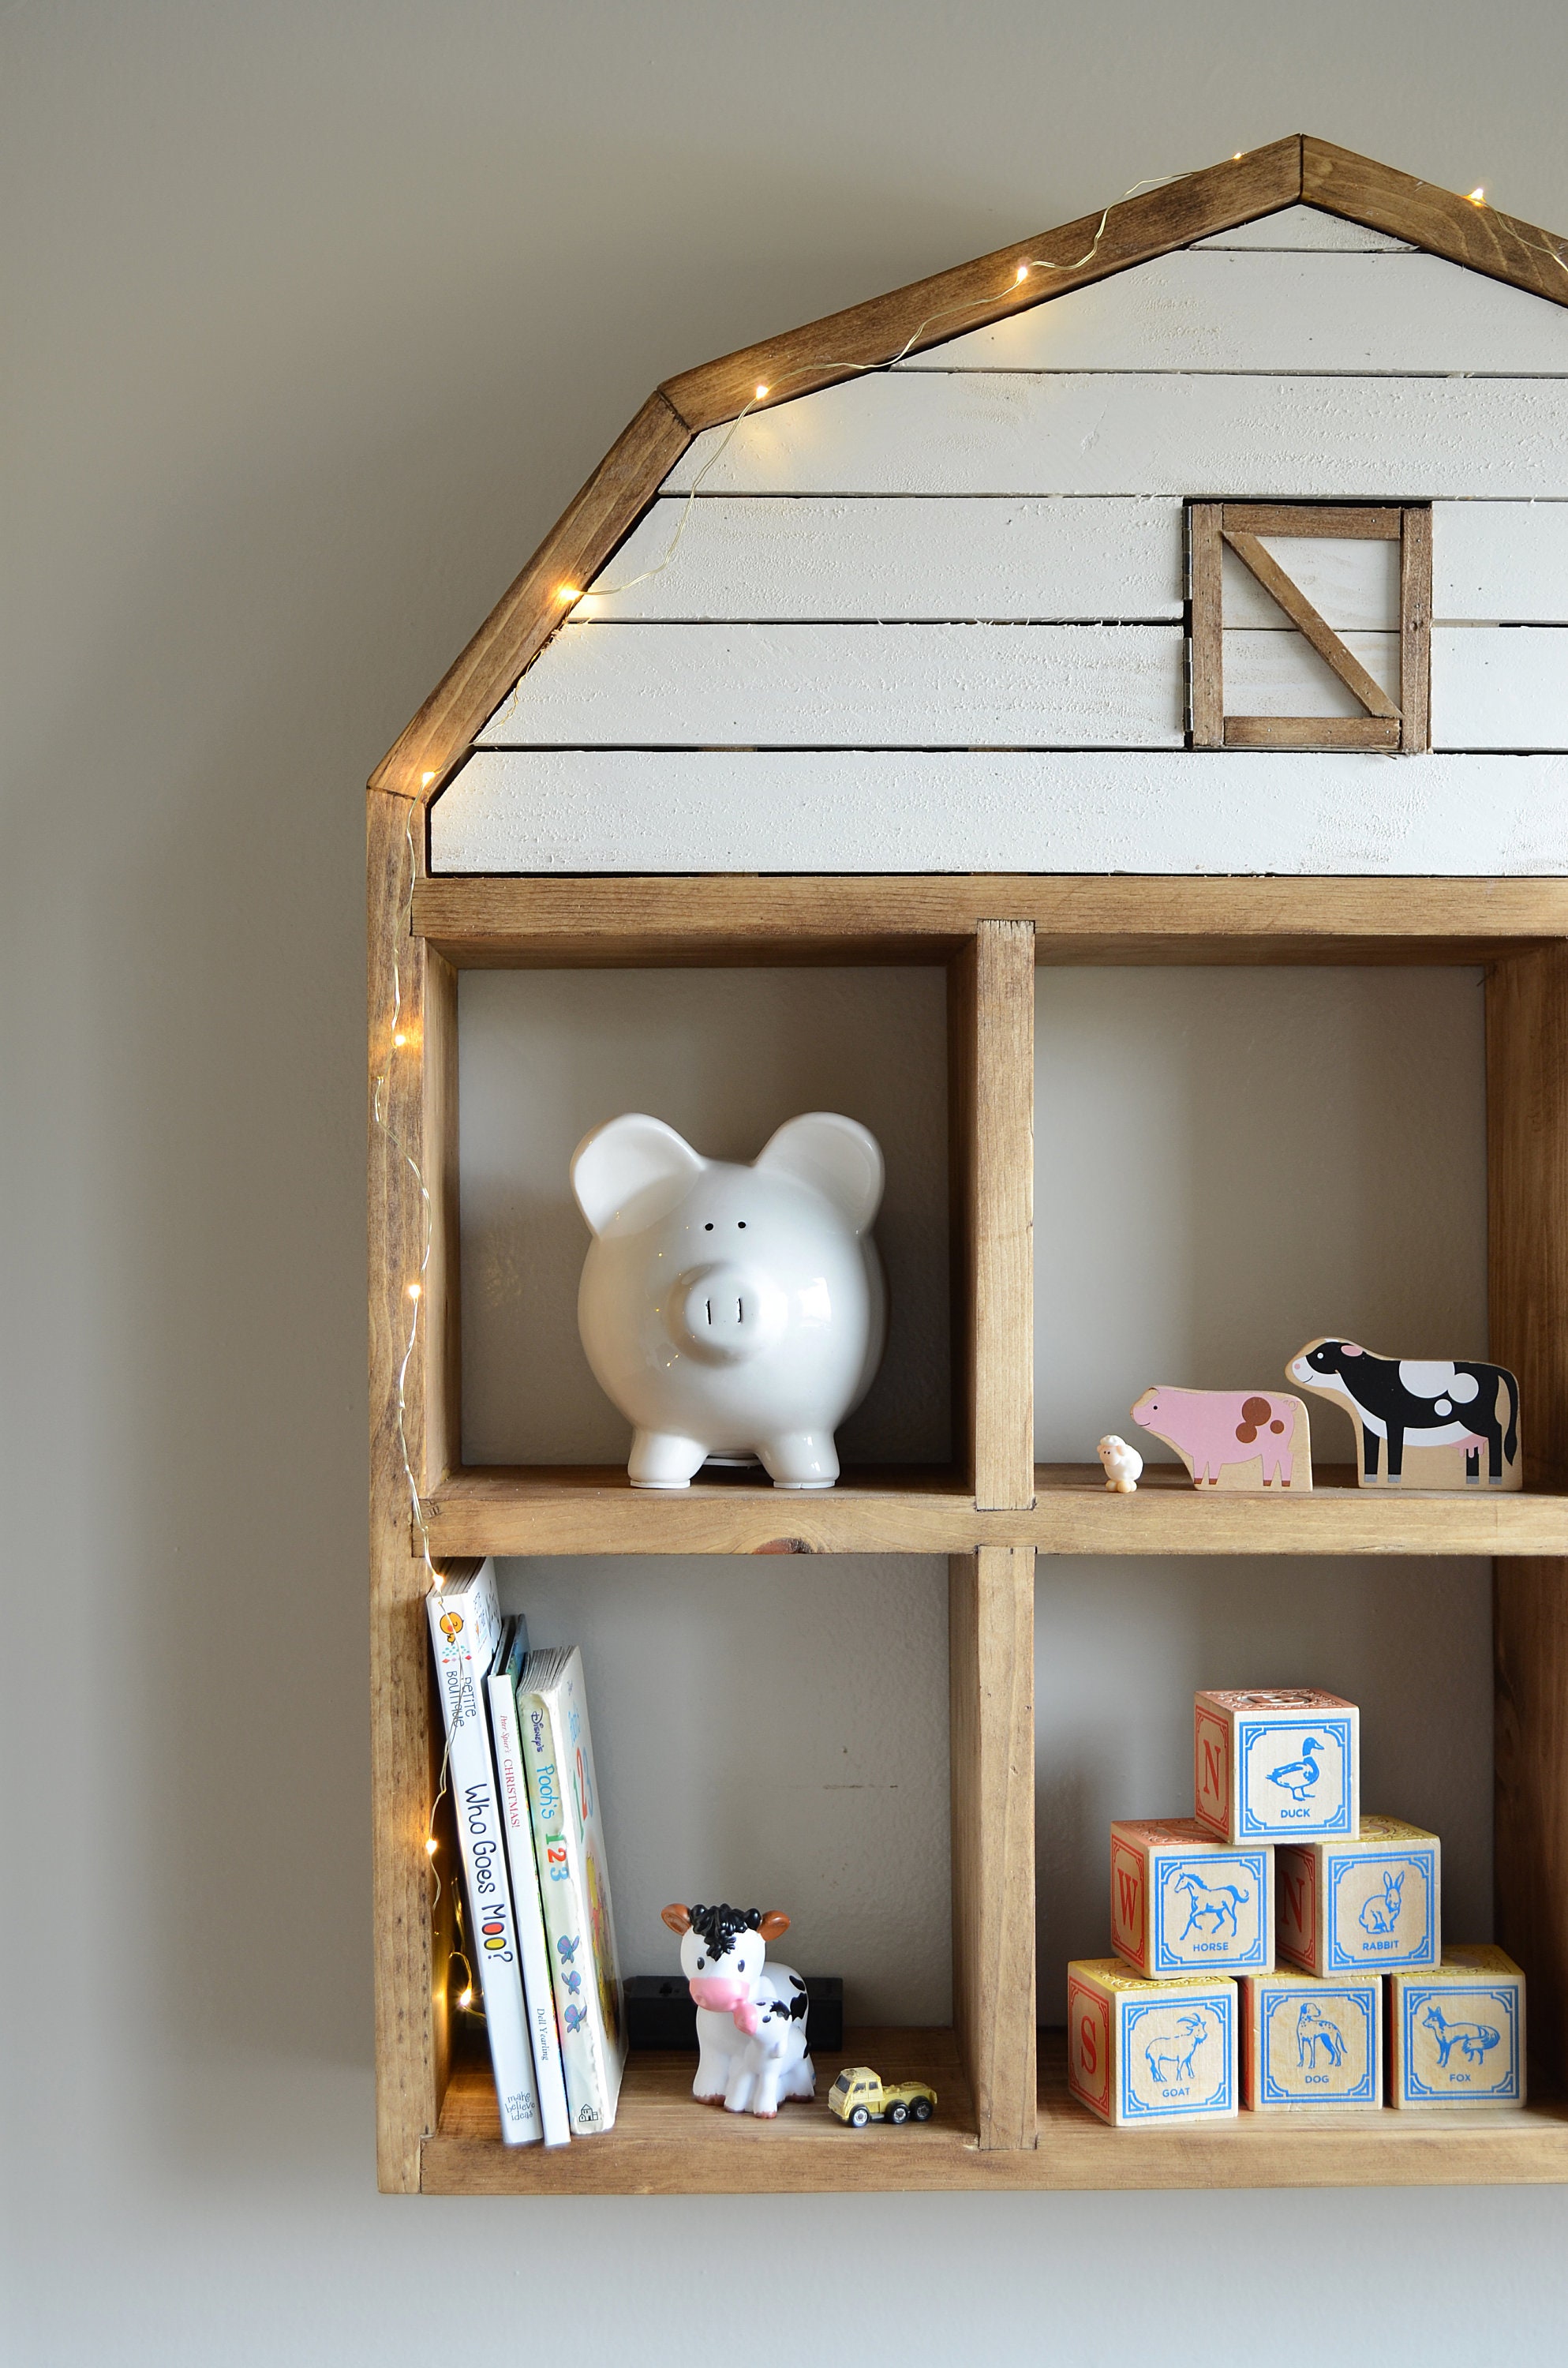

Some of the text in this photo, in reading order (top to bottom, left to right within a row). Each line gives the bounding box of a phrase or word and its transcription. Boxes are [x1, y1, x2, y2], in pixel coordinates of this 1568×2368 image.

[500, 1733, 511, 1754] Spier's
[1203, 1739, 1221, 1801] N
[503, 1759, 521, 1828] CHRISTMAS!
[464, 1783, 490, 1834] Who
[1280, 1808, 1311, 1818] DUCK
[536, 1763, 569, 1882] Pooh's 1 2 3
[472, 1840, 497, 1894] Goes
[1117, 1867, 1138, 1931] W
[1280, 1869, 1305, 1933] N
[1192, 1942, 1229, 1952] HORSE
[1362, 1939, 1399, 1950] RABBIT
[537, 2008, 550, 2061] Dell Yearling
[1080, 2015, 1097, 2074] S
[1304, 2074, 1330, 2084] DOG
[1449, 2073, 1472, 2082] FOX
[507, 2091, 531, 2103] make
[1162, 2087, 1190, 2097] GOAT
[504, 2101, 536, 2114] believe
[511, 2110, 533, 2121] ideas
